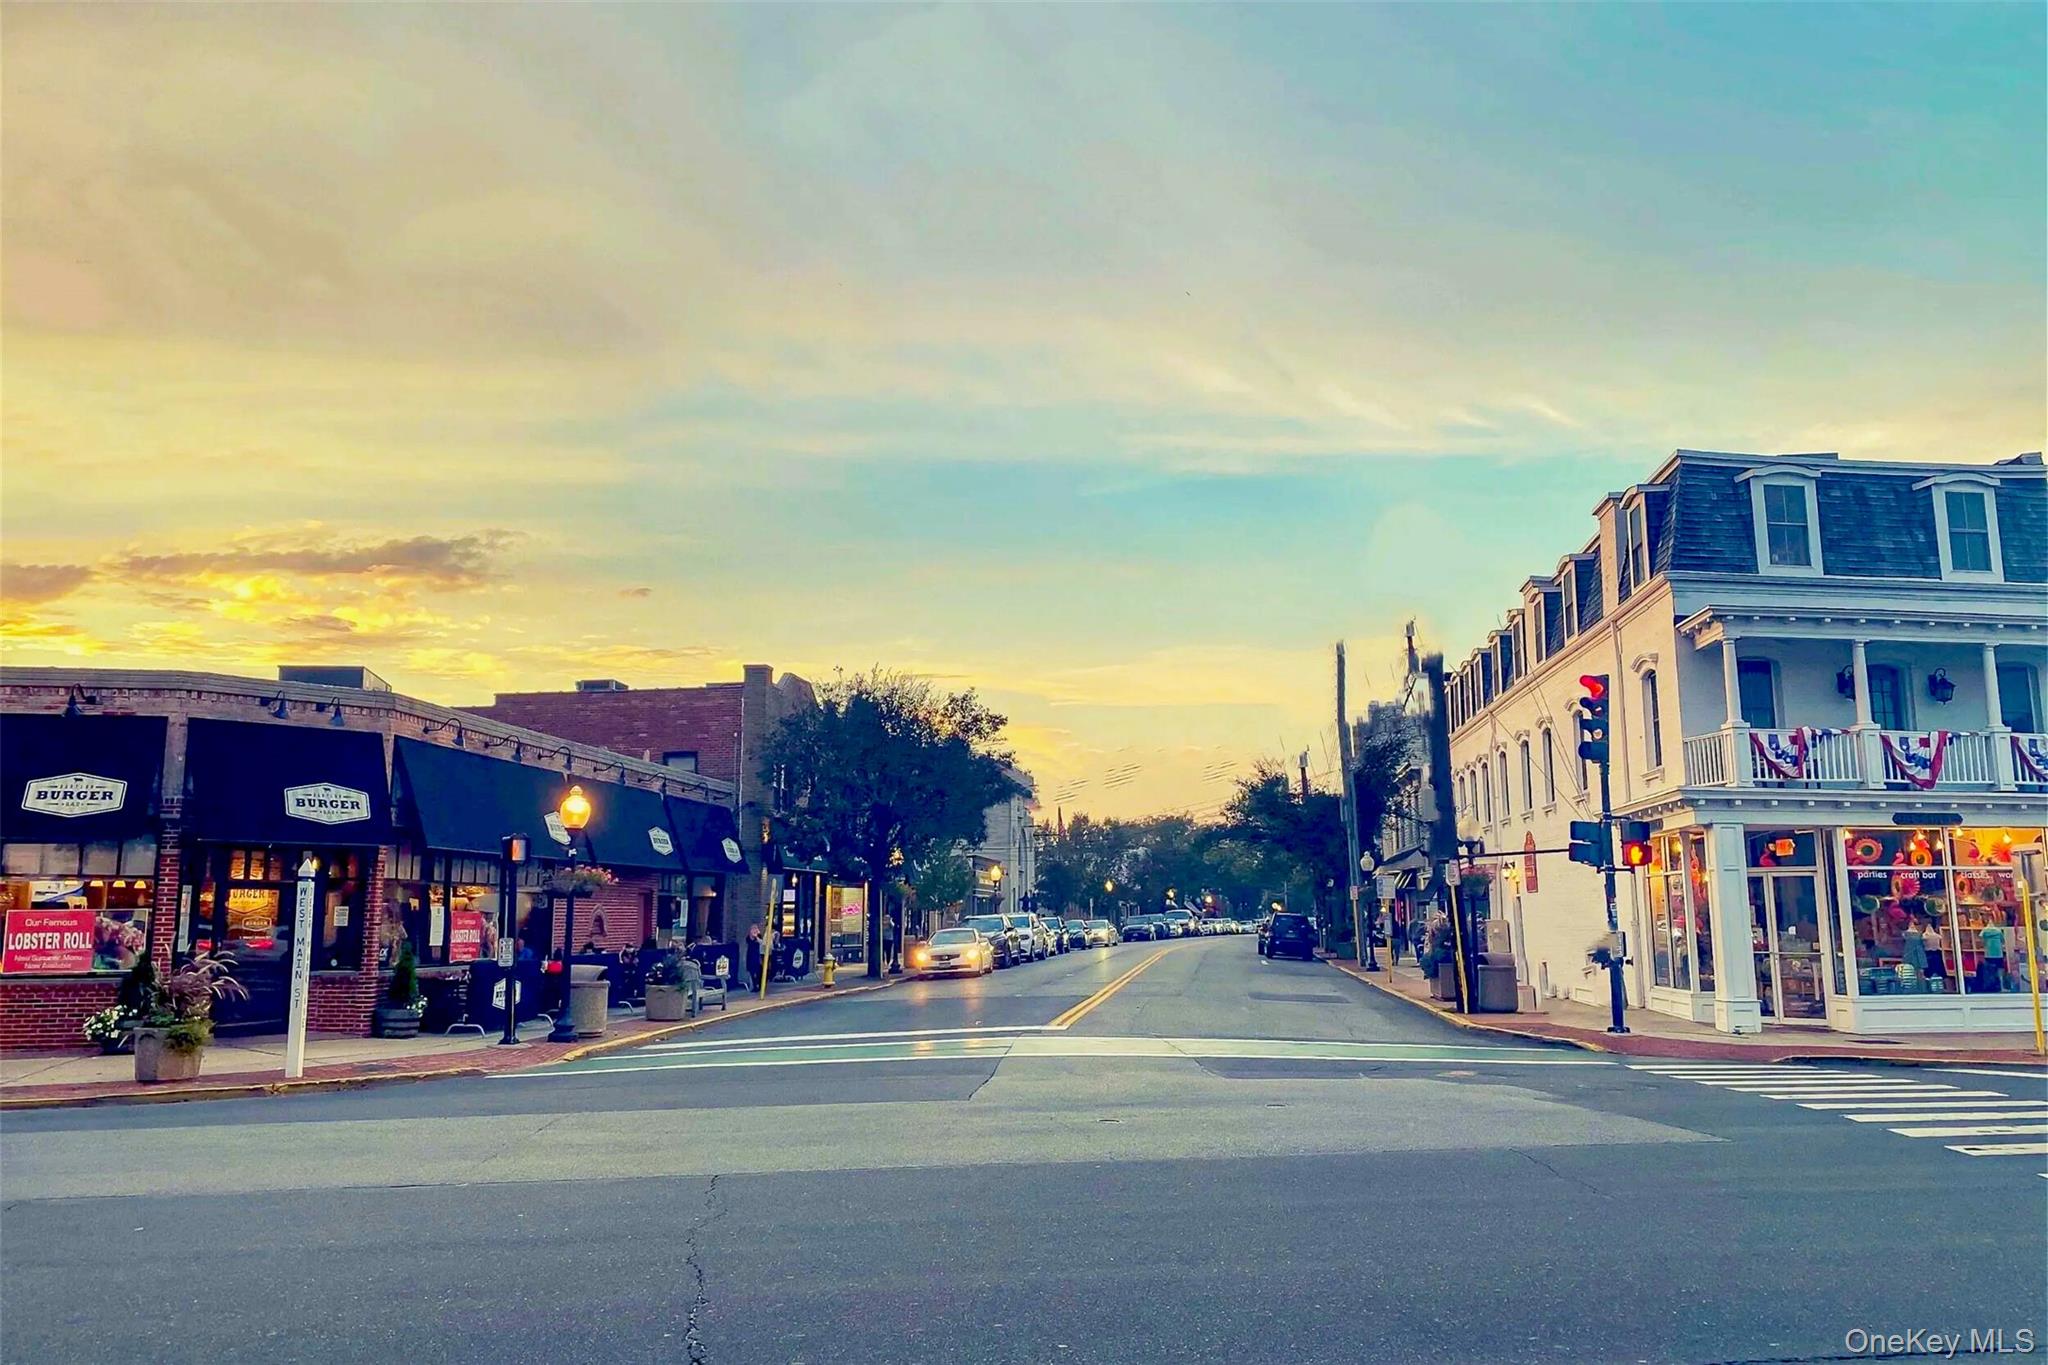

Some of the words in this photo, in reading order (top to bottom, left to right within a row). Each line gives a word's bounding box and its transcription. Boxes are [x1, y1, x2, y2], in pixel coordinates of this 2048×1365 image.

[36, 790, 114, 801] BURGER
[295, 798, 361, 810] BURGER
[1857, 871, 1888, 880] parties
[1900, 871, 1920, 880] craft
[1922, 871, 1937, 880] bar
[231, 889, 266, 899] URGER
[299, 887, 307, 928] WEST
[25, 918, 42, 927] Our
[43, 918, 78, 927] Famous
[8, 932, 60, 950] LOBSTER
[63, 932, 92, 949] ROLL
[295, 938, 305, 980] MAIN
[294, 988, 301, 1008] ST
